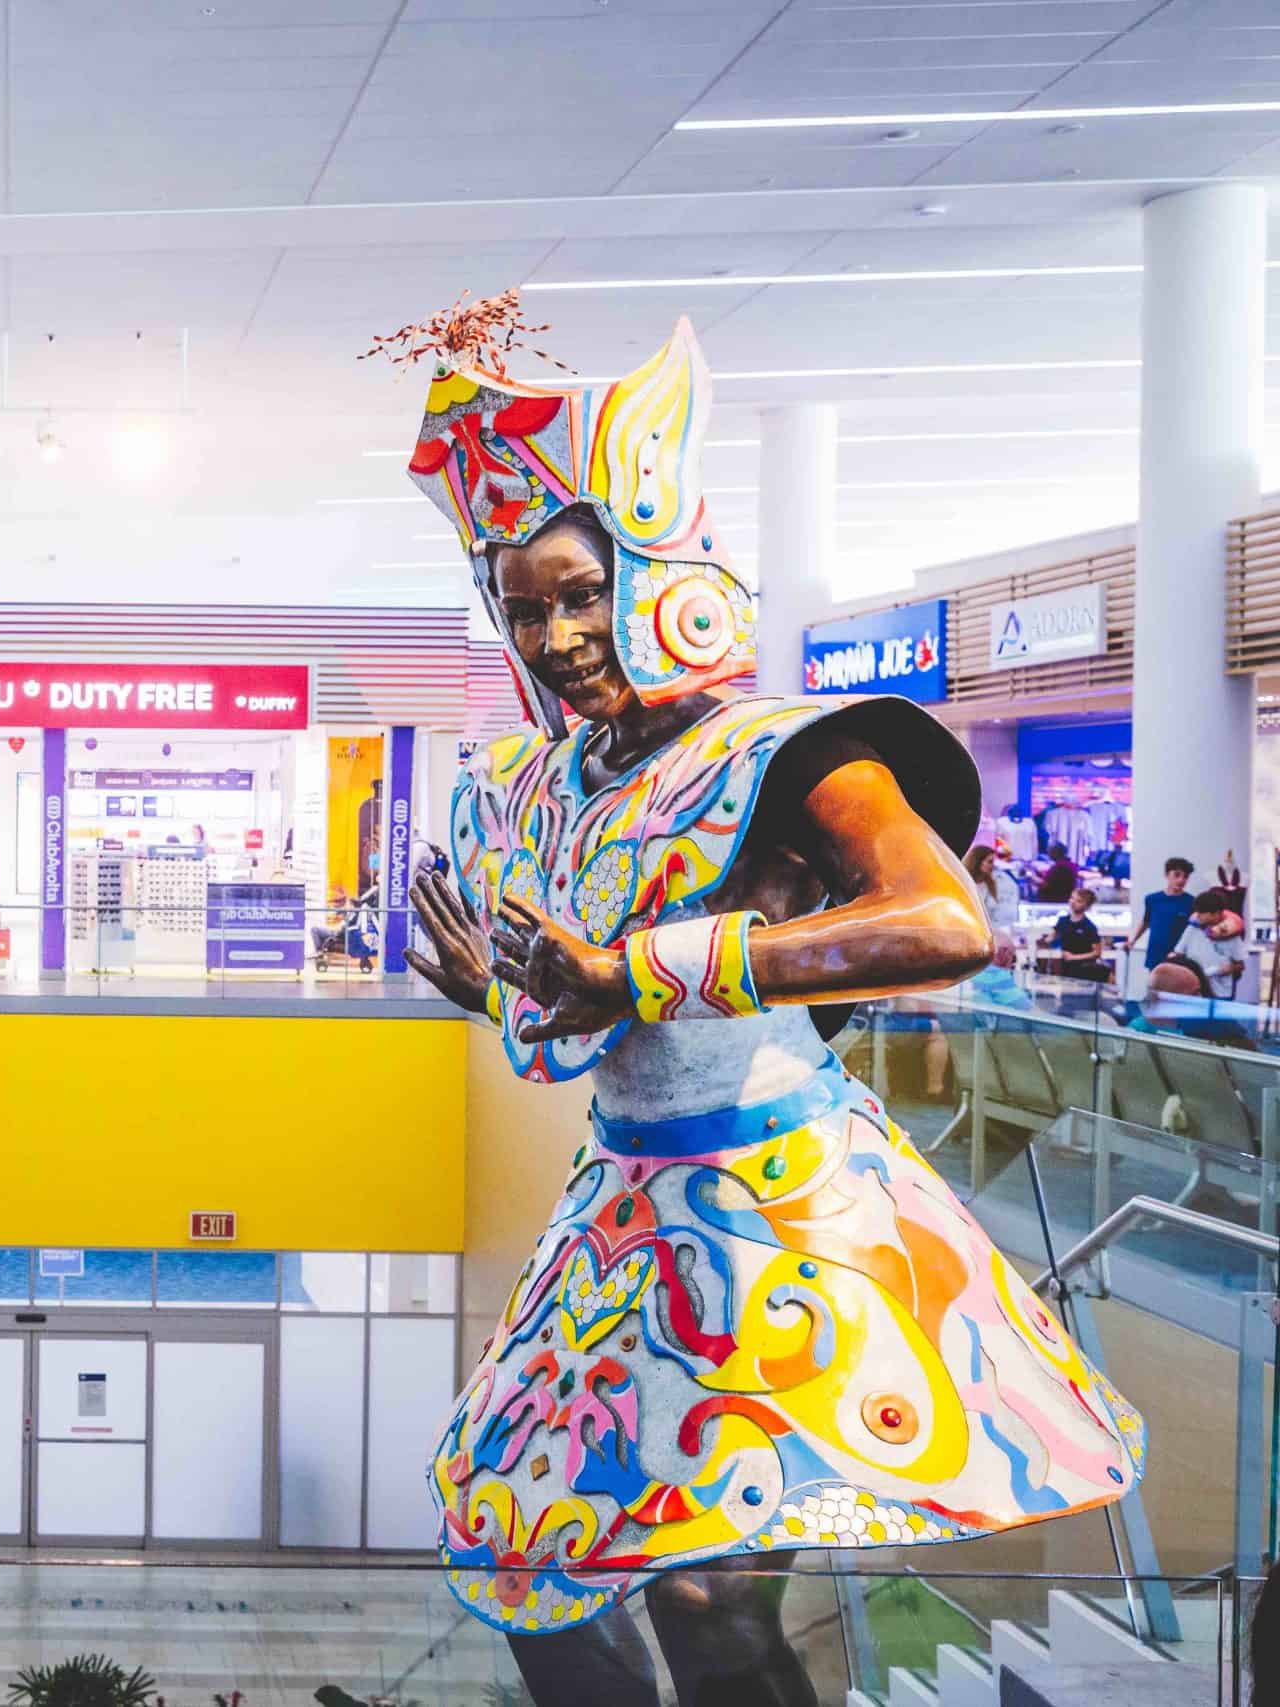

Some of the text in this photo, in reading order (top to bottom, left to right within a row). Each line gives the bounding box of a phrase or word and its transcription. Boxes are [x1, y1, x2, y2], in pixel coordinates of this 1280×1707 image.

[878, 636, 913, 679] JOE
[49, 682, 133, 710] DUTY
[138, 682, 213, 711] FREE
[248, 696, 296, 711] DUFRY
[46, 821, 61, 903] ClubAvolta
[391, 825, 408, 906] ClubAvolta
[200, 1215, 227, 1236] EXIT
